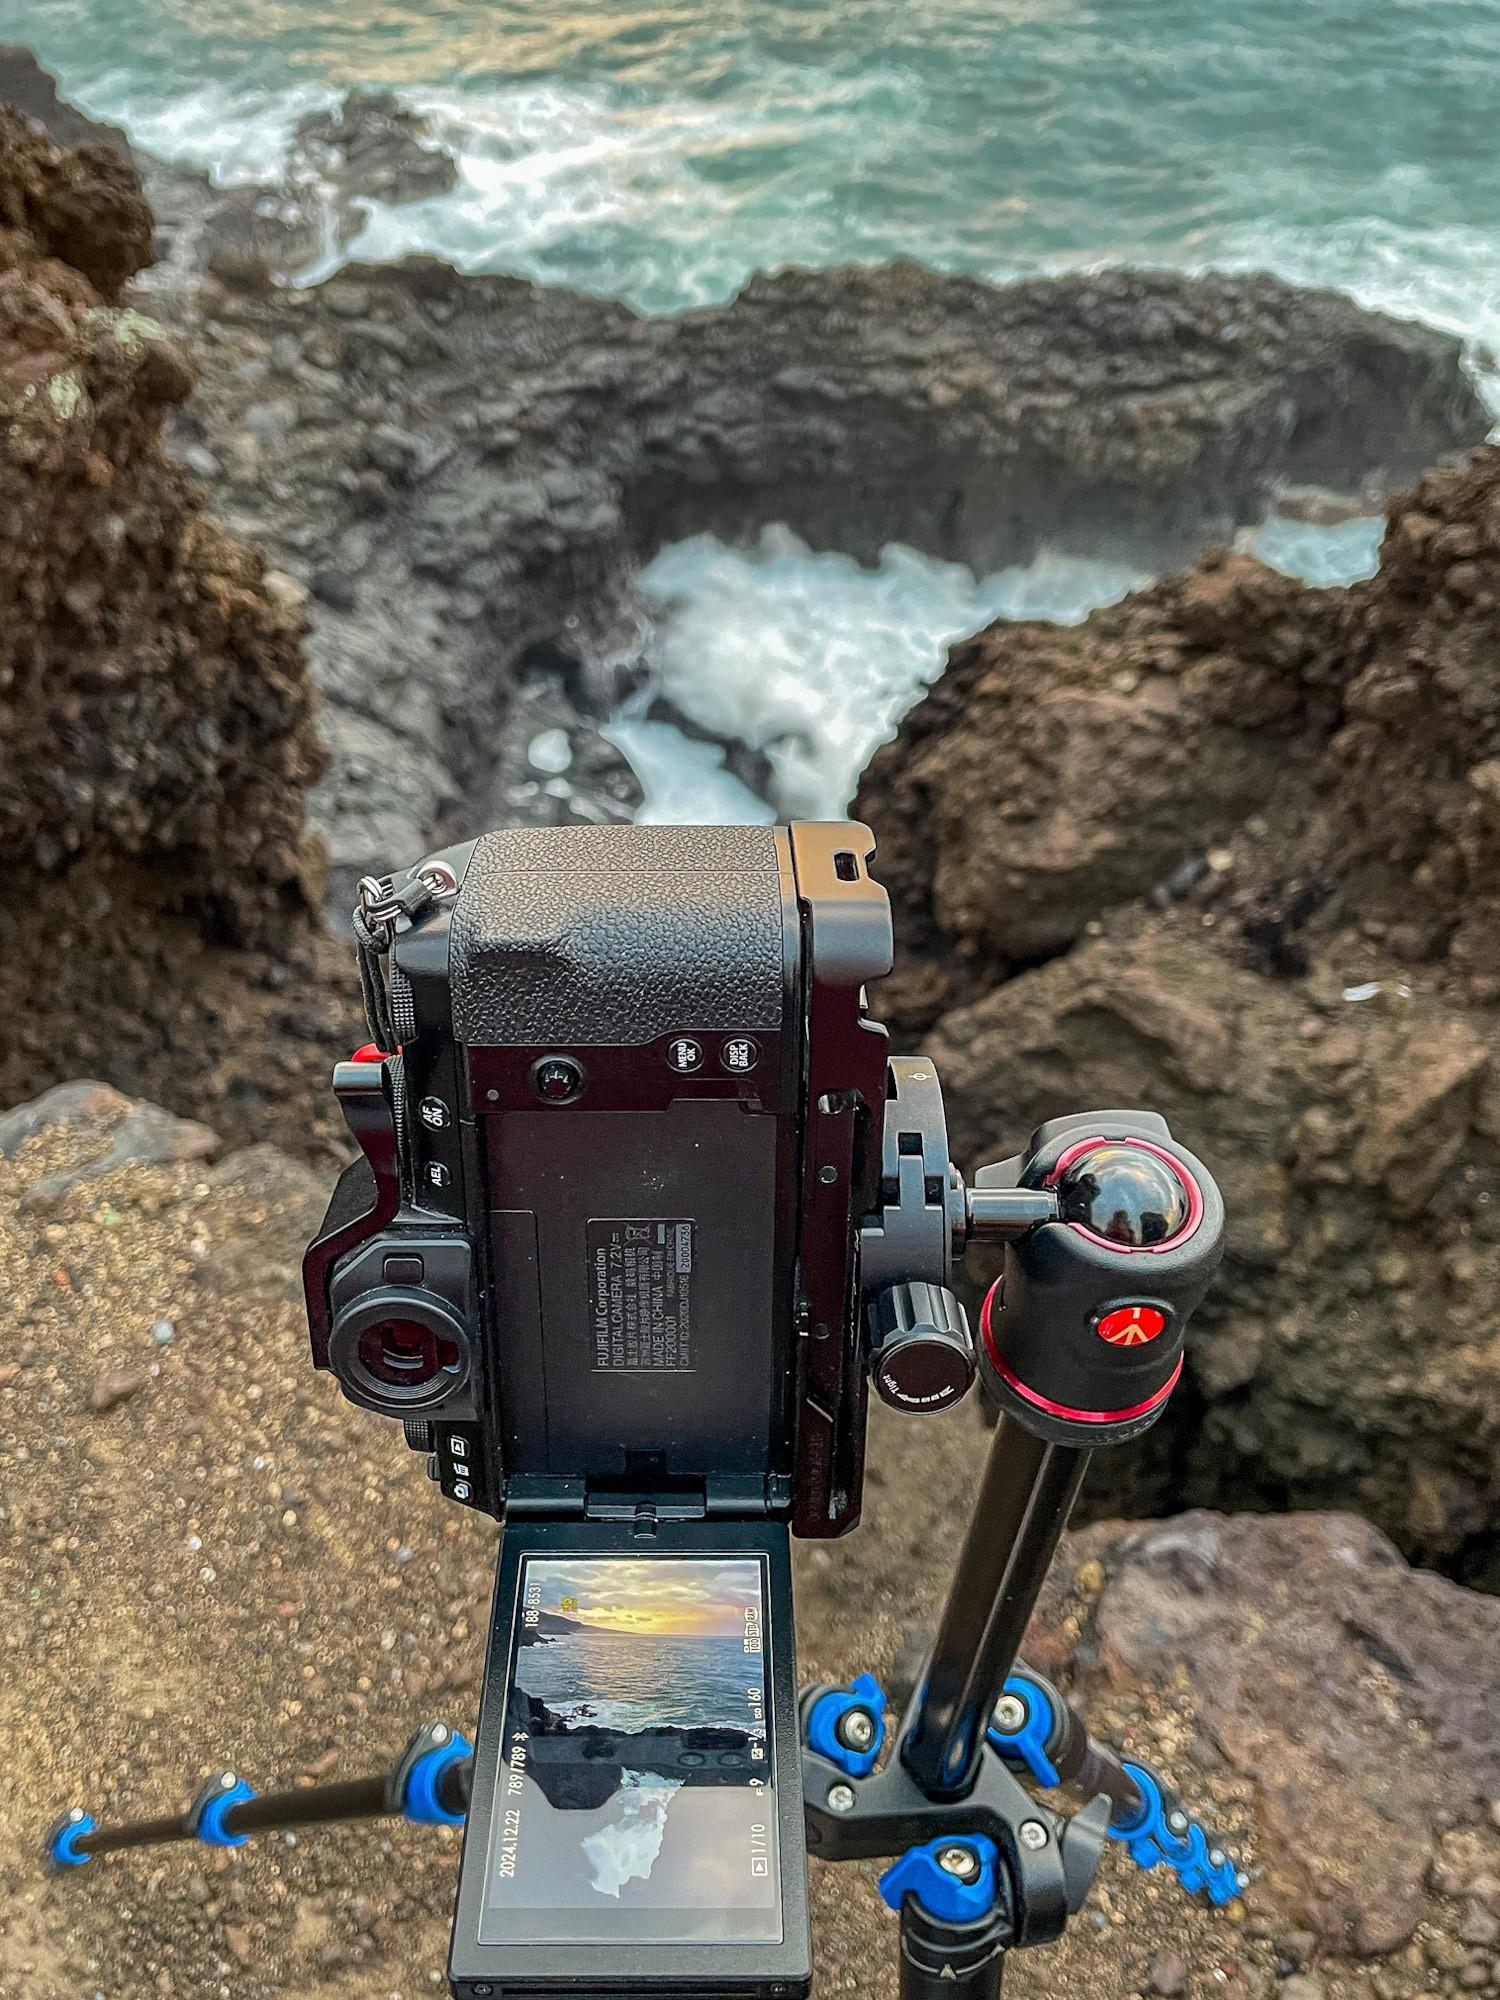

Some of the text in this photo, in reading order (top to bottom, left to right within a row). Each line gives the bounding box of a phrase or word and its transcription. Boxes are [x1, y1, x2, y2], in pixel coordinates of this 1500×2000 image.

[678, 1043, 687, 1067] MENU
[687, 1048, 696, 1061] OK
[729, 1045, 739, 1065] DISP
[739, 1044, 748, 1066] BACK
[423, 1106, 432, 1122] AF
[431, 1107, 443, 1126] ON
[430, 1166, 442, 1187] AEL
[594, 1248, 609, 1366] FUJIFILM Corporation
[652, 1285, 665, 1367] MADE IN CHINA
[665, 1315, 677, 1367] FF200001
[499, 1746, 526, 1878] 2024.12.22 789/789
[748, 1823, 765, 1854] 1/10
